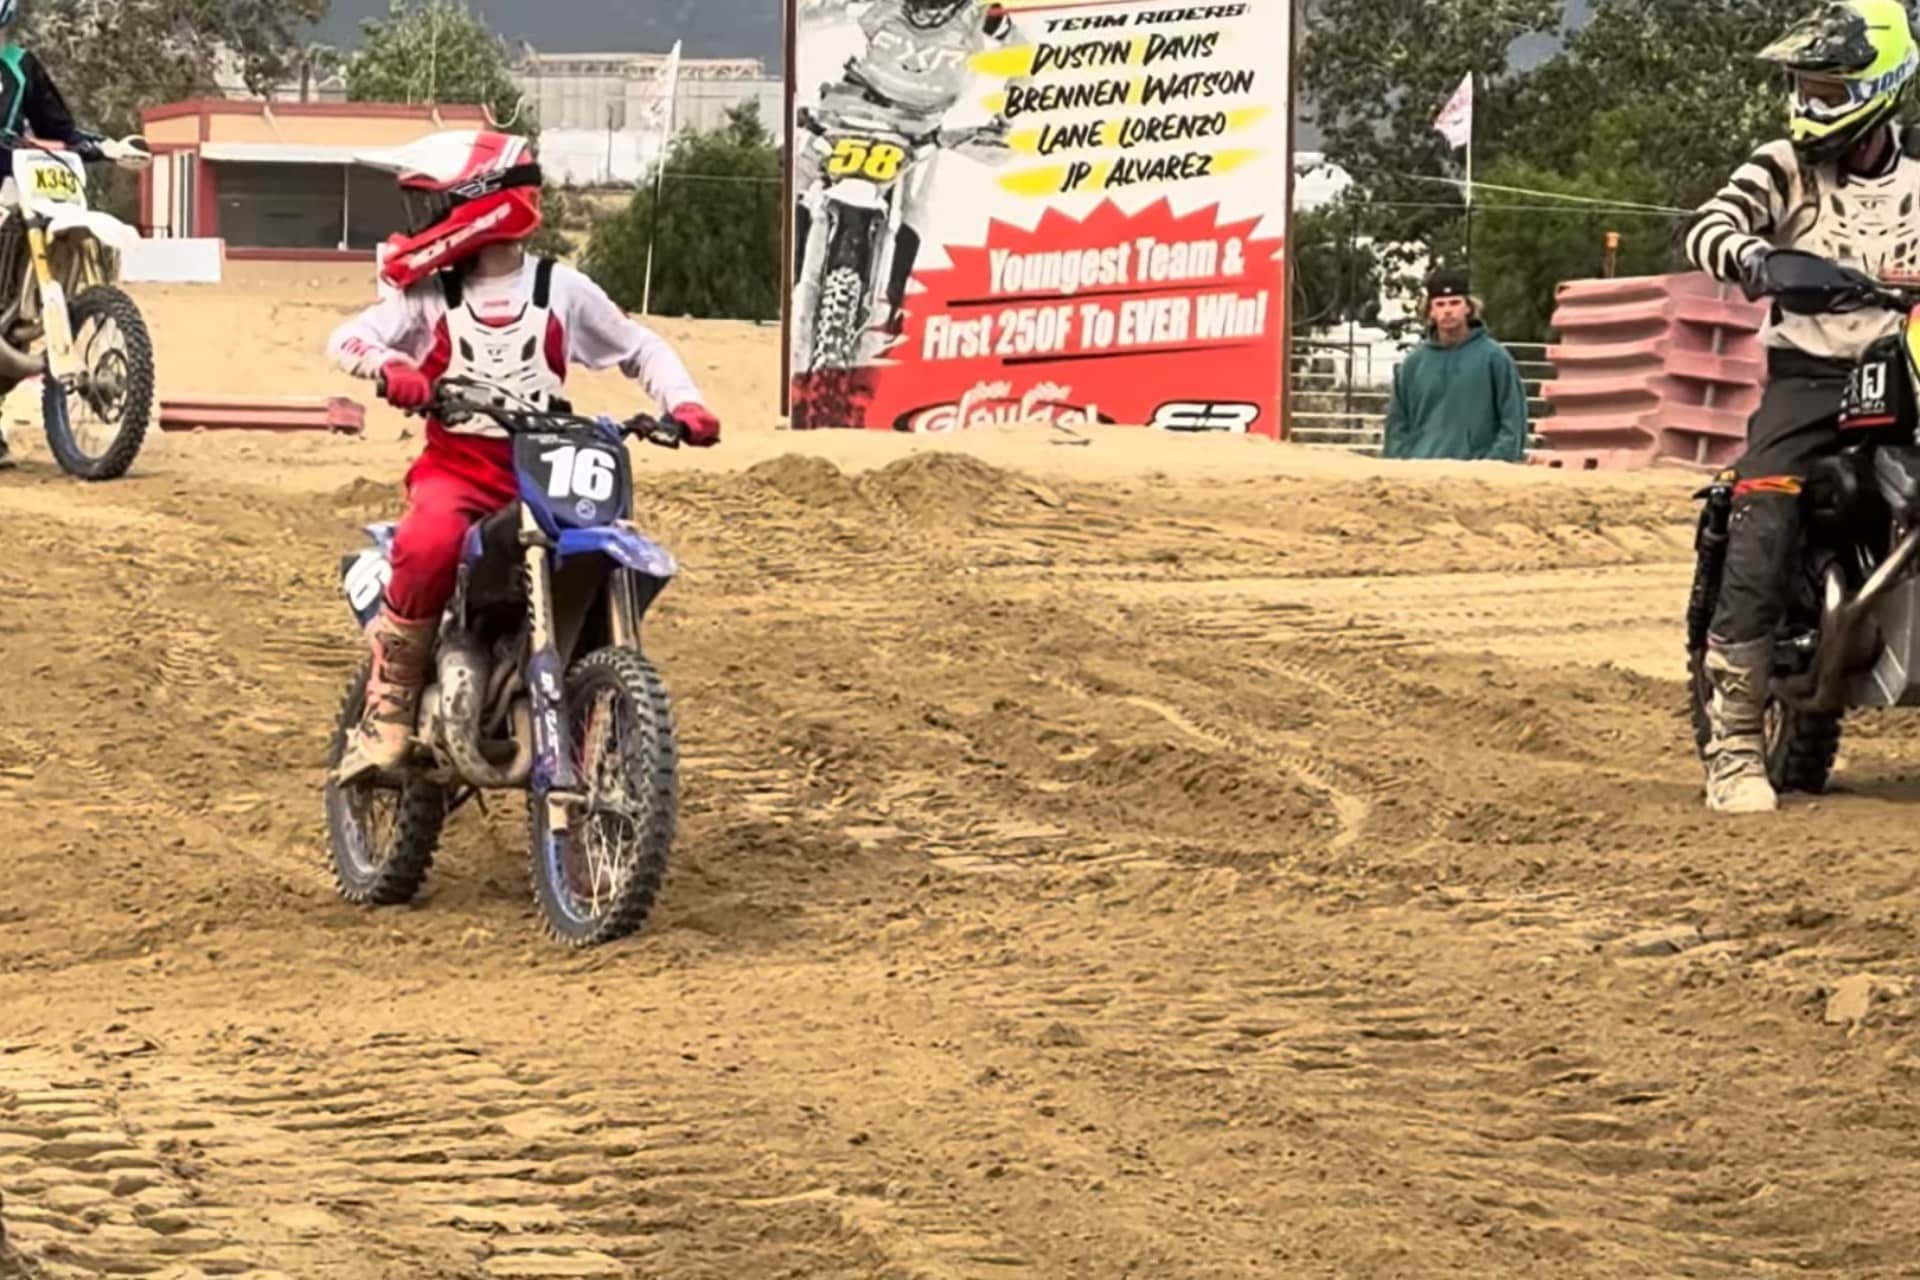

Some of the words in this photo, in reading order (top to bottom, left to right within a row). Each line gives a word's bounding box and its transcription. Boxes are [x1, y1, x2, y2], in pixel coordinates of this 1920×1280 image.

[1044, 14, 1129, 33] TEAM
[1030, 40, 1132, 76] DUSTYN
[1143, 31, 1220, 66] DAVIS
[1004, 79, 1130, 119] BRENNEN
[1140, 70, 1255, 106] WATSON
[1037, 120, 1104, 155] LANE
[1117, 111, 1227, 148] LORENZO
[827, 137, 905, 182] 58
[1061, 160, 1093, 193] JP
[1105, 153, 1213, 190] ALVAREZ
[989, 242, 1131, 295] Youngest
[1135, 237, 1218, 280] Team
[1221, 236, 1245, 277] &
[922, 313, 993, 361] First
[998, 305, 1074, 355] 250F
[1080, 305, 1118, 349] To
[1118, 296, 1190, 346] EVER
[1196, 290, 1268, 339] Win!
[540, 445, 617, 501] 16
